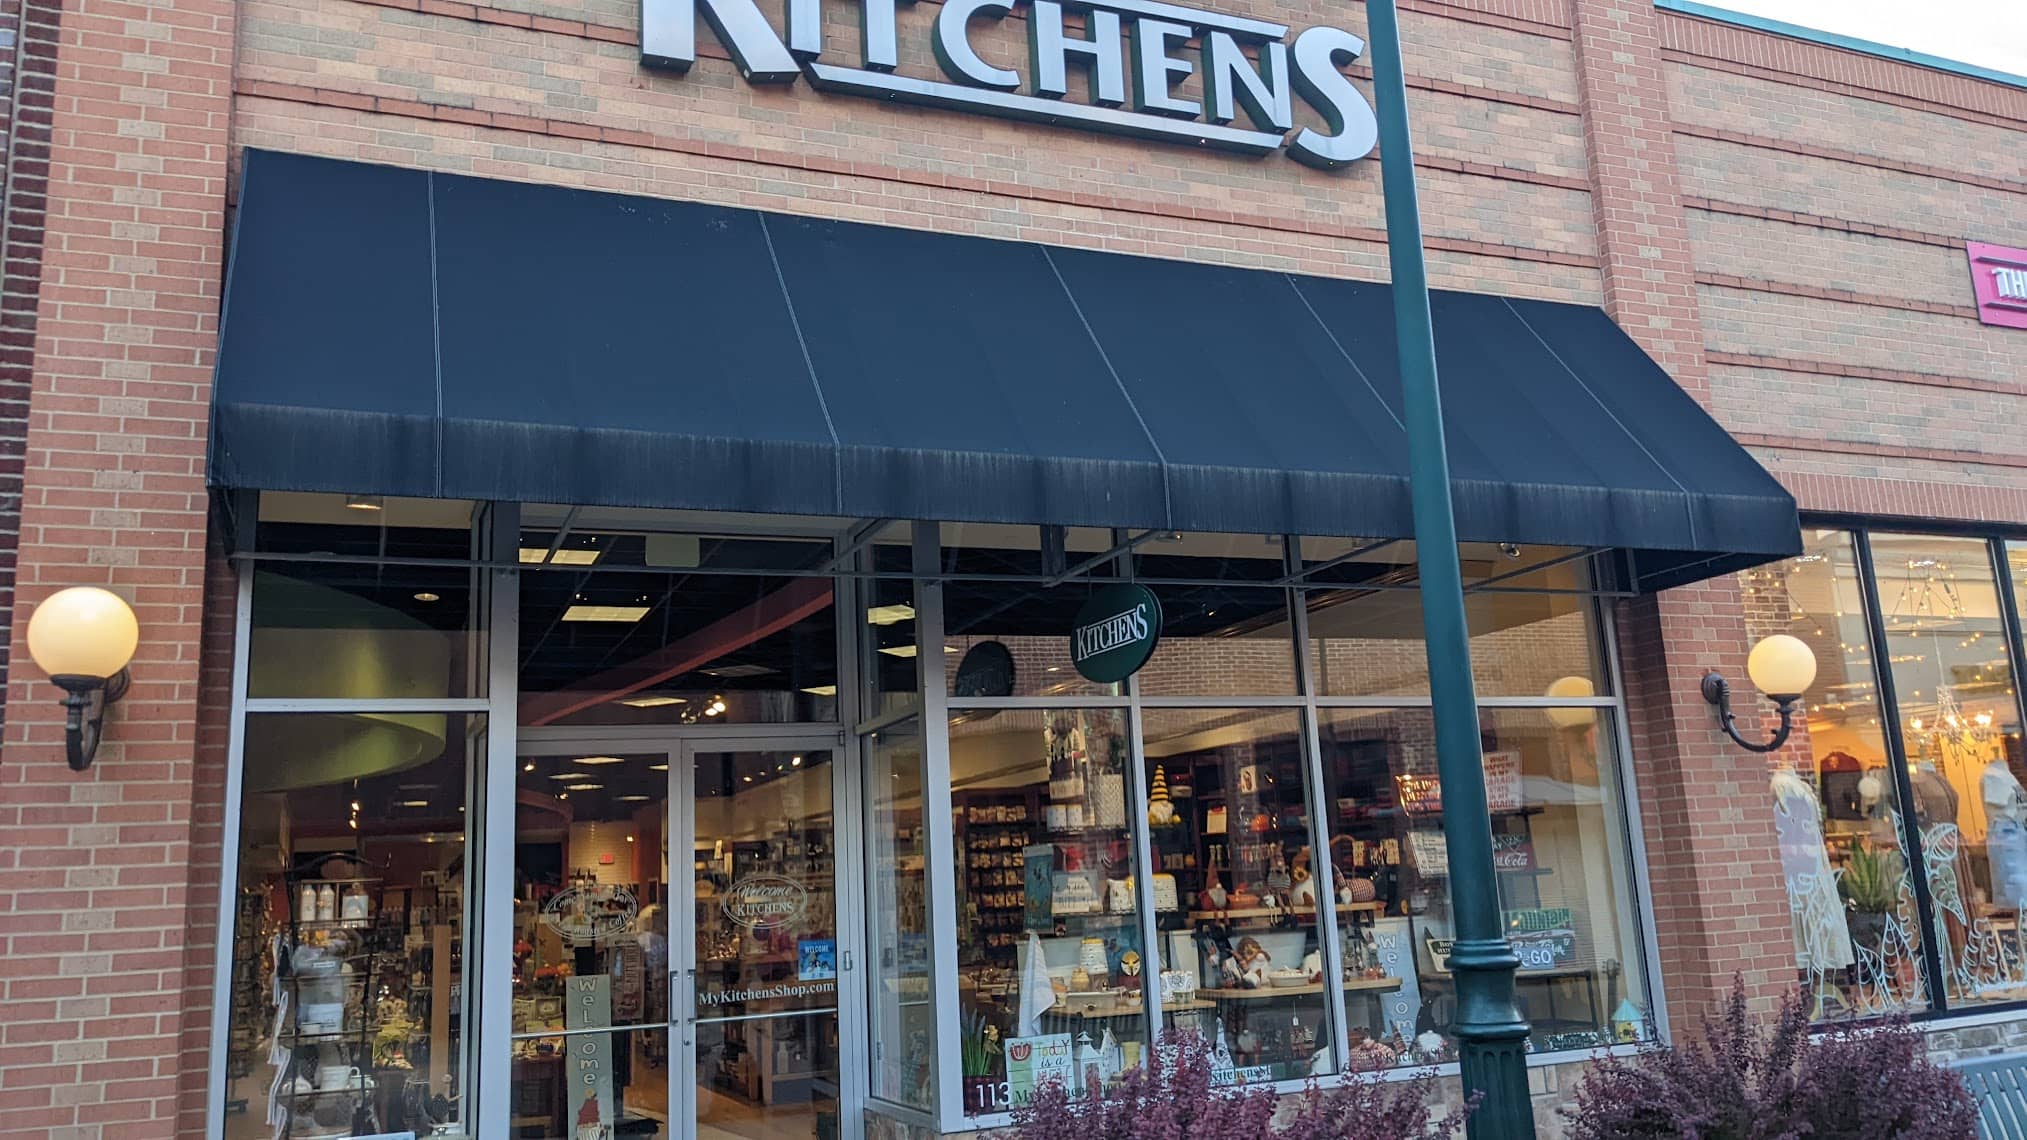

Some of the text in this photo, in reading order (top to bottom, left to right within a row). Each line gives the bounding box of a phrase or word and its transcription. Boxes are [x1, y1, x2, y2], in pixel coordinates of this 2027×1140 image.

[640, 0, 1379, 167] KITCHENS
[1076, 603, 1148, 661] KITCHENS
[737, 885, 793, 899] Welcome
[737, 901, 794, 917] KITCHENS
[804, 944, 830, 954] WELCOME
[699, 982, 835, 1007] MyKitchensShop.com
[976, 1082, 1010, 1108] 113
